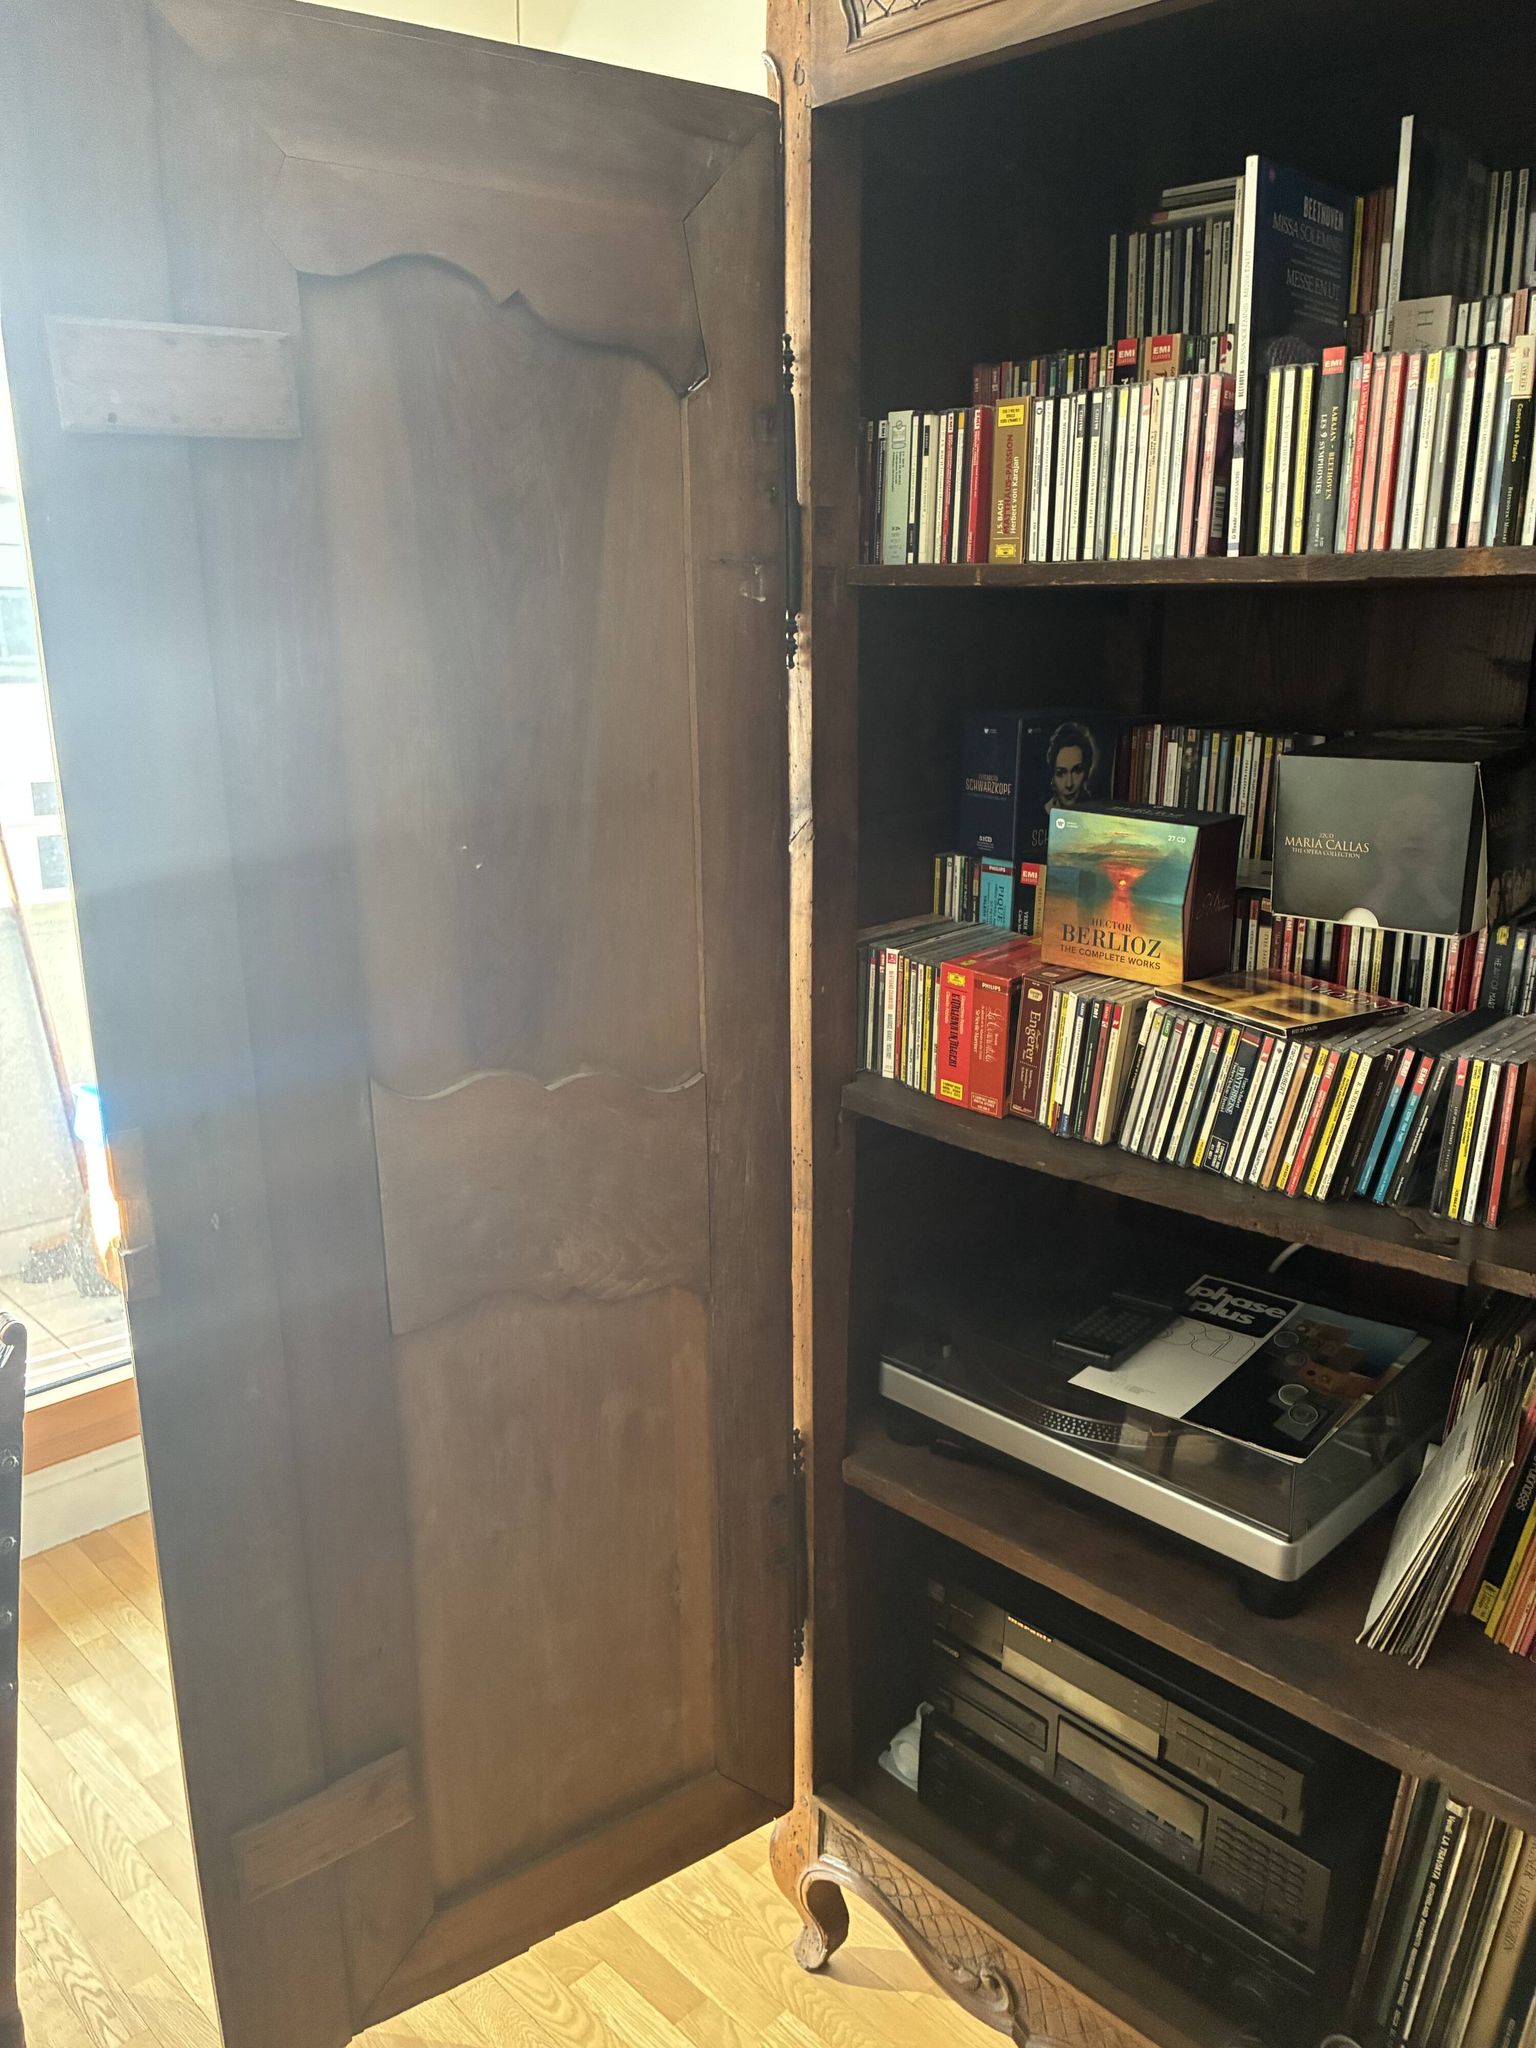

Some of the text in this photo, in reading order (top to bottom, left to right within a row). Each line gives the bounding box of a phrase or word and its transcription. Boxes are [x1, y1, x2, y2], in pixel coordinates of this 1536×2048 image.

[1304, 196, 1344, 232] BEETHOVEN
[1118, 350, 1135, 358] EMI
[1152, 345, 1170, 354] EMI
[1325, 359, 1342, 368] EMI
[1320, 414, 1328, 428] LES
[1514, 403, 1523, 433] Concerts
[1326, 406, 1338, 500] KARAJAN BEETHOVEN
[1012, 456, 1020, 492] Karajan
[1316, 441, 1325, 495] SYMPHONIES
[966, 778, 1012, 796] SCHWARZKOPF
[1168, 834, 1186, 844] 27 CD
[1284, 836, 1370, 853] MARIA CALLAS
[1022, 870, 1038, 878] EMI
[1092, 918, 1132, 932] HECTOR
[1062, 924, 1162, 958] BERLIOZ
[1060, 944, 1160, 970] THE COMPLETE WORKS
[982, 982, 1001, 992] PHILIPS
[1025, 1011, 1040, 1062] Engerer
[1278, 1061, 1293, 1095] SCHUBERT
[1417, 1067, 1428, 1085] EMI
[1225, 1066, 1246, 1115] WINTERREISE
[1188, 1286, 1287, 1319] phase
[1189, 1300, 1255, 1325] plus
[1432, 1845, 1448, 1880] TRAVIATA
